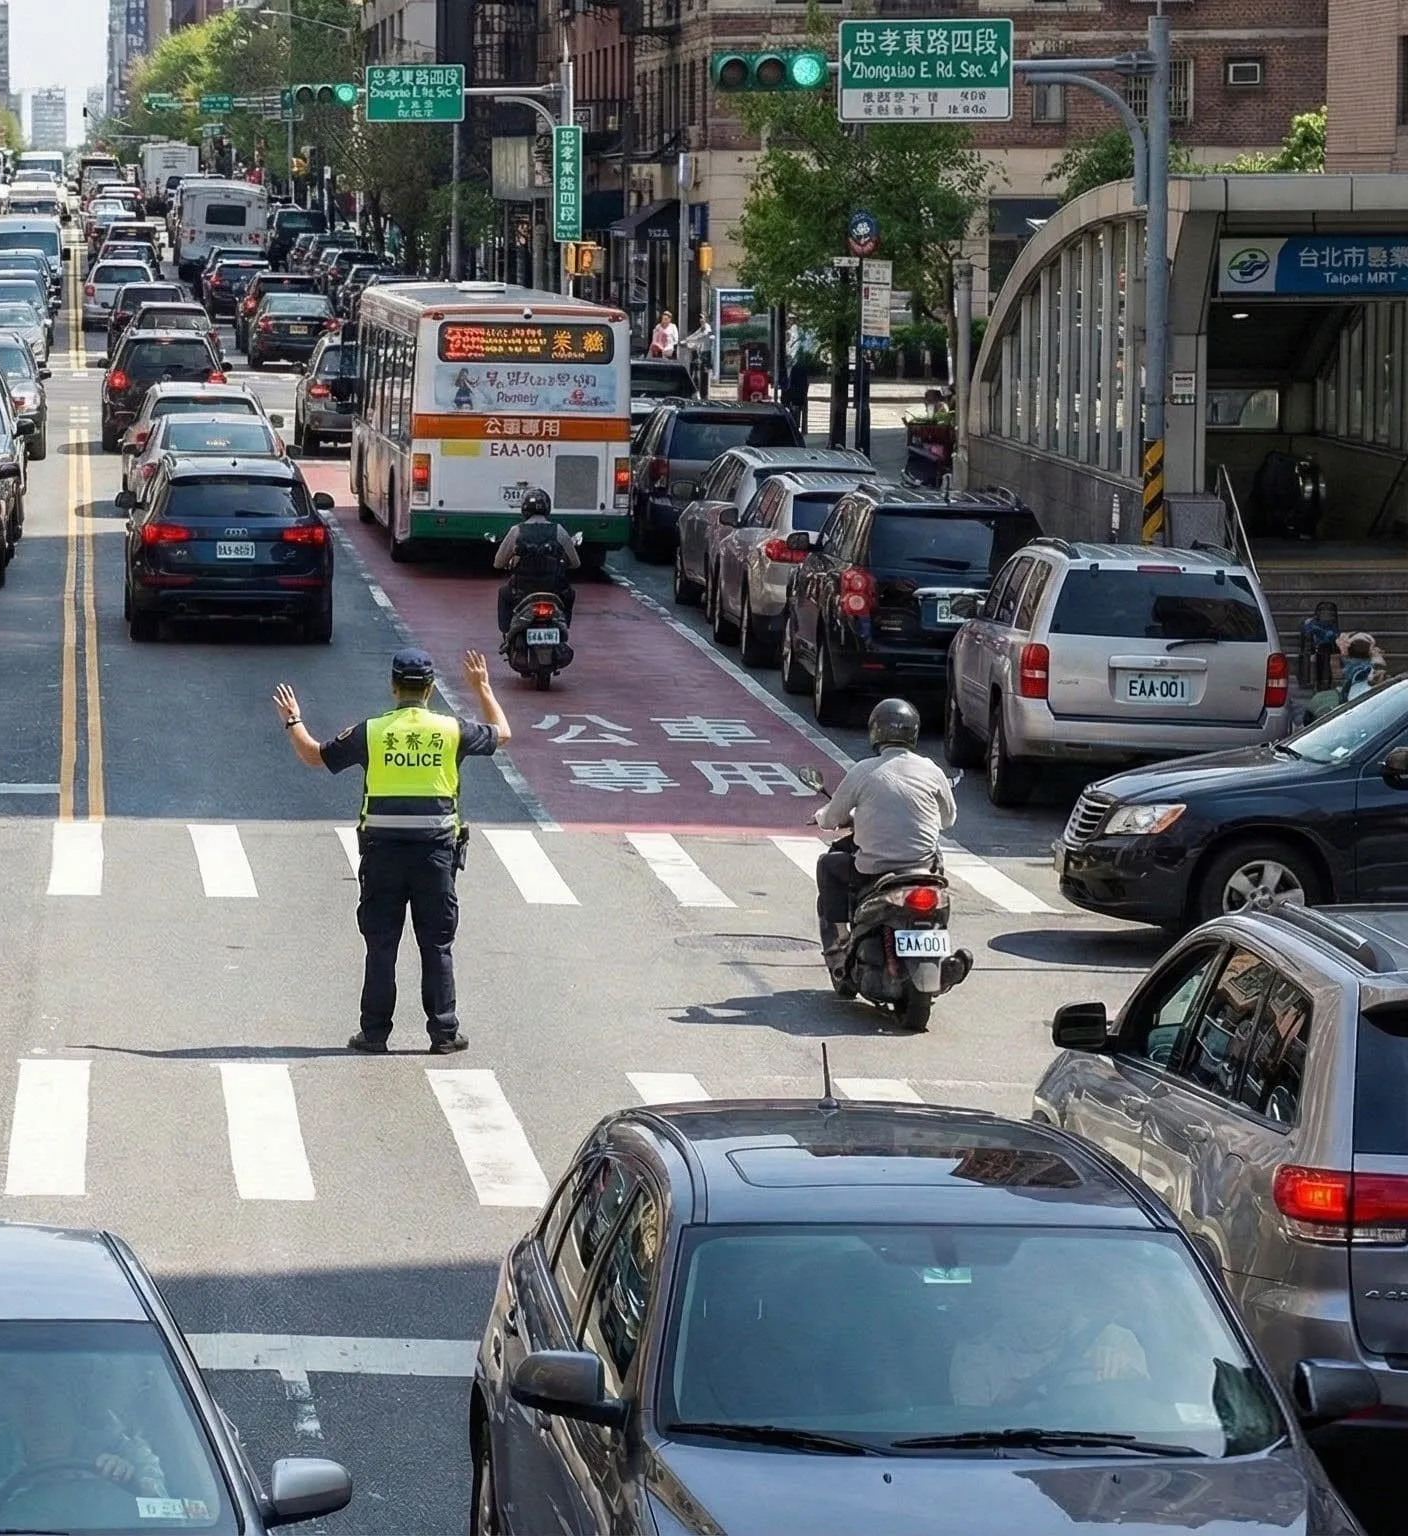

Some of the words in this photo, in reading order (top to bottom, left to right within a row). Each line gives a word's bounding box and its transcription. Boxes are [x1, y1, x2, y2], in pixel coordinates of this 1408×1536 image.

[853, 27, 998, 57] 忠孝東路四段
[852, 61, 915, 82] Zhongxiao
[920, 62, 932, 78] E.
[936, 61, 956, 78] Rd.
[960, 60, 987, 78] Sec.
[989, 60, 998, 77] 4
[1324, 271, 1363, 286] Taipei
[1367, 271, 1397, 284] MRT
[490, 443, 552, 458] EAA-001
[1128, 679, 1185, 698] EAA-001
[531, 714, 771, 747] 公車
[384, 752, 442, 767] POLICE
[562, 758, 817, 797] 專用
